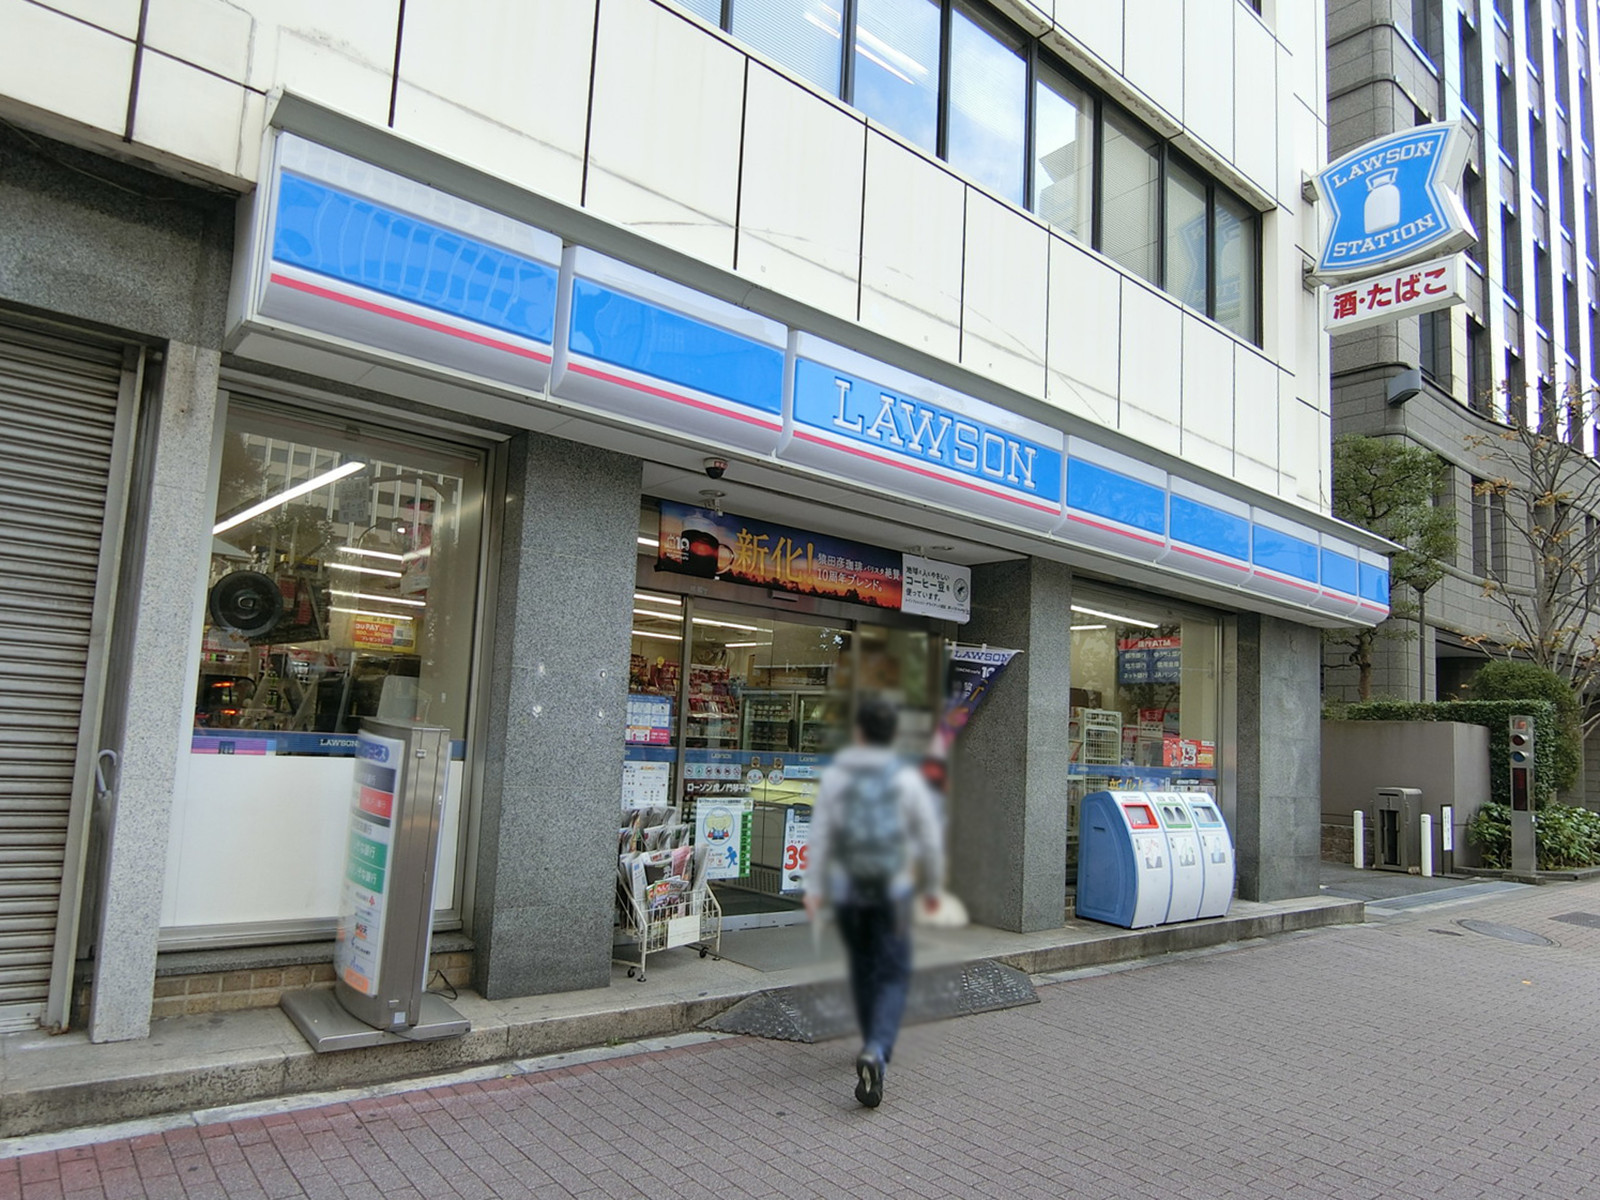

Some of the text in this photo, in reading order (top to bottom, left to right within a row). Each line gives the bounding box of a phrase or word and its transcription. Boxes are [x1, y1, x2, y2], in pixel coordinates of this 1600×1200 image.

[1332, 140, 1435, 189] LAWSON
[1332, 213, 1436, 258] STATION
[1333, 267, 1447, 320] 酒・たばこ
[832, 376, 1037, 490] LAWSON
[954, 650, 1012, 663] LAWSON
